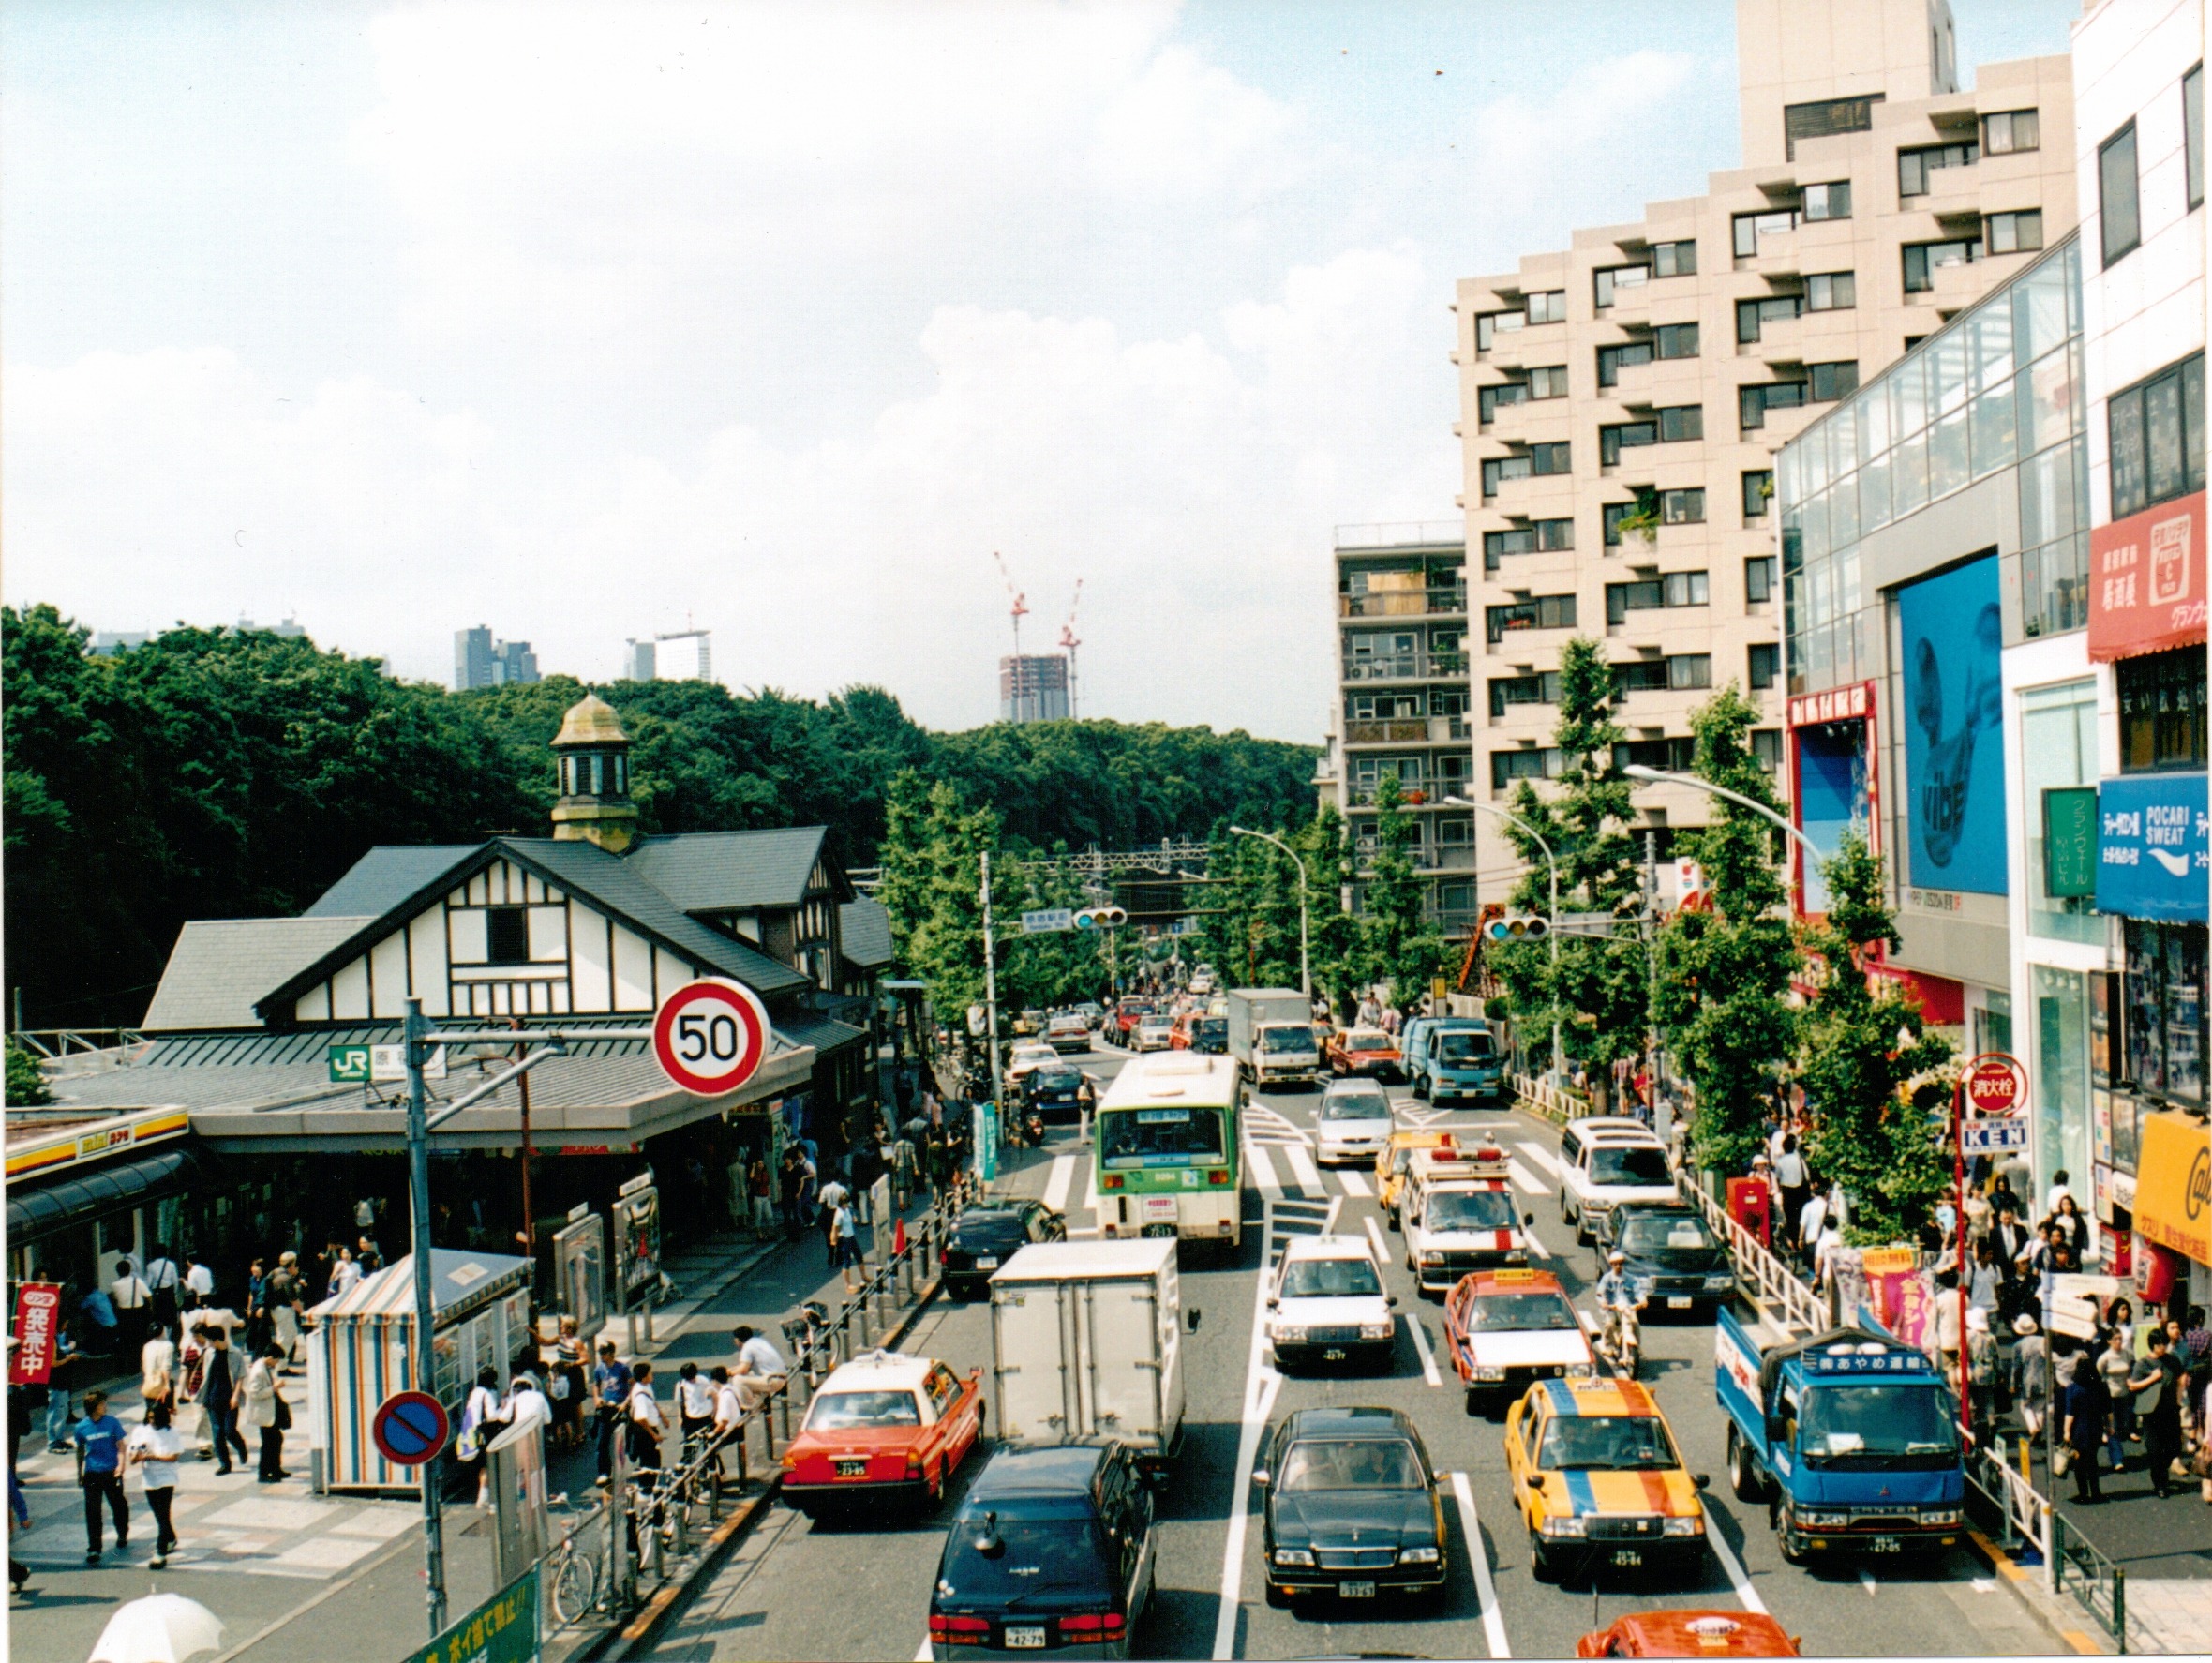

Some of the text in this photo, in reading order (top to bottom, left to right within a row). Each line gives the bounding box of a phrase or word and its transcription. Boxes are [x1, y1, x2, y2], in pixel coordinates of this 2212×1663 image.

[2146, 805, 2189, 826] POCARI
[2145, 826, 2185, 846] SWEAT
[679, 1014, 738, 1062] 50
[334, 1050, 367, 1071] JR
[1973, 1078, 2014, 1098] 消火栓
[1968, 1128, 2024, 1146] KEN
[21, 1307, 51, 1377] 発売中
[1013, 1634, 1044, 1646] 42-79
